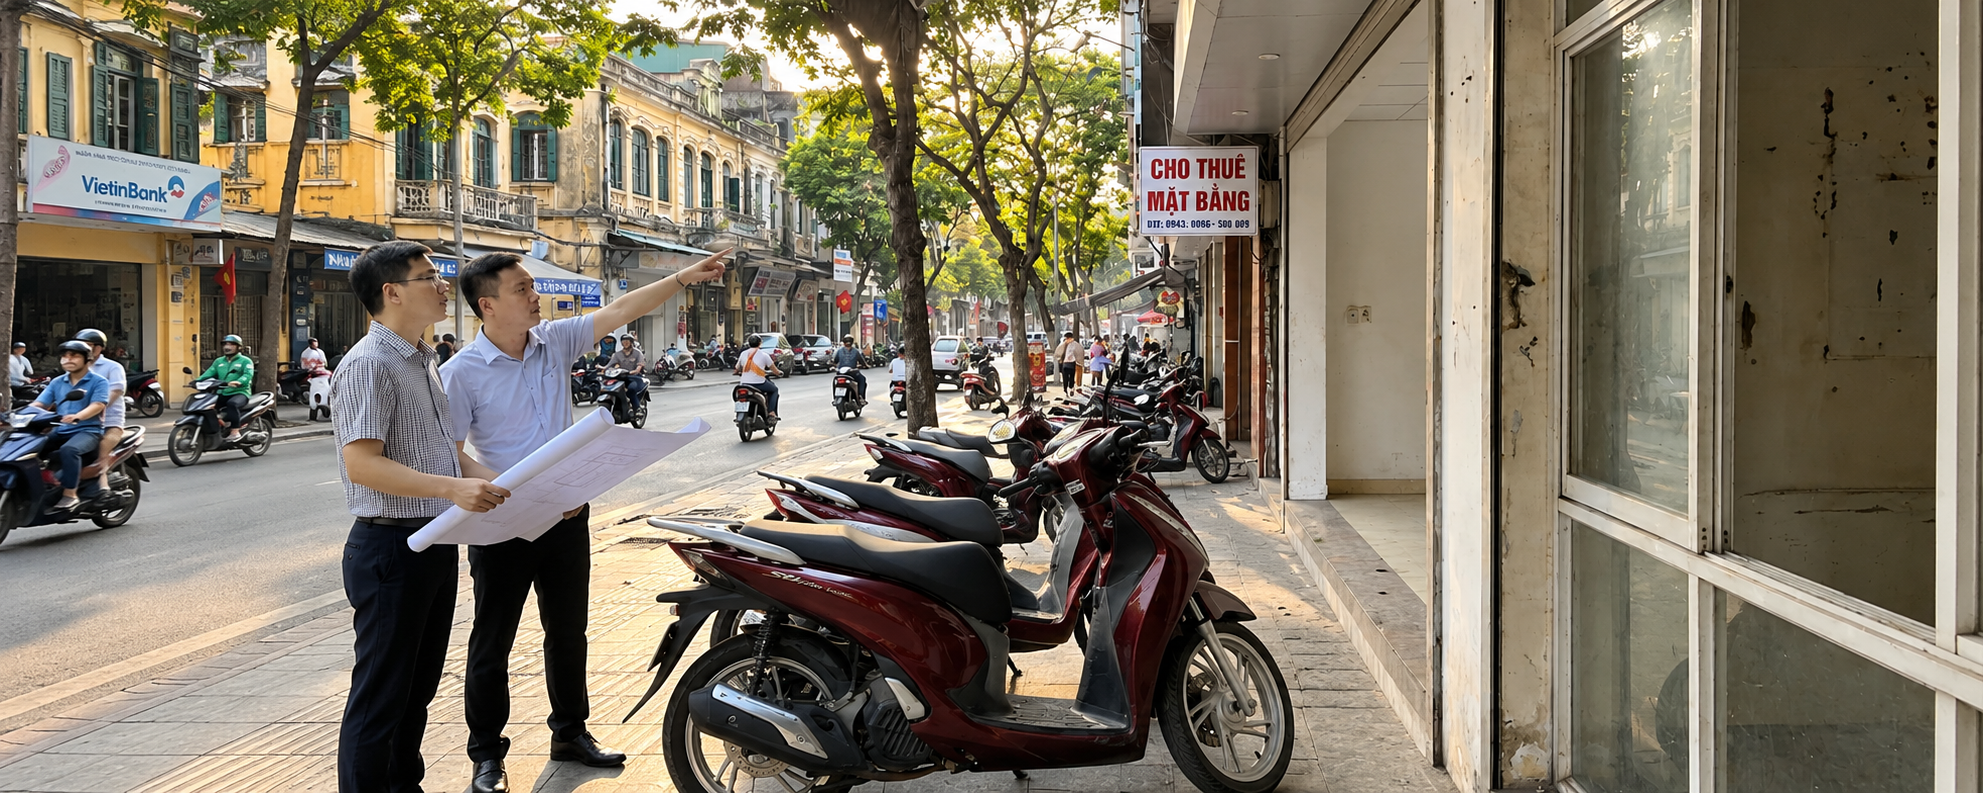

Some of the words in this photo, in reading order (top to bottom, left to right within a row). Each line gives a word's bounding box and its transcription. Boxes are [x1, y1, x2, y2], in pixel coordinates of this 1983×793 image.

[1151, 158, 1190, 179] CHO
[1196, 153, 1246, 179] THUÊ
[82, 175, 168, 203] VietinBank
[1147, 186, 1190, 216] MẶT
[1196, 183, 1250, 212] BẰNG
